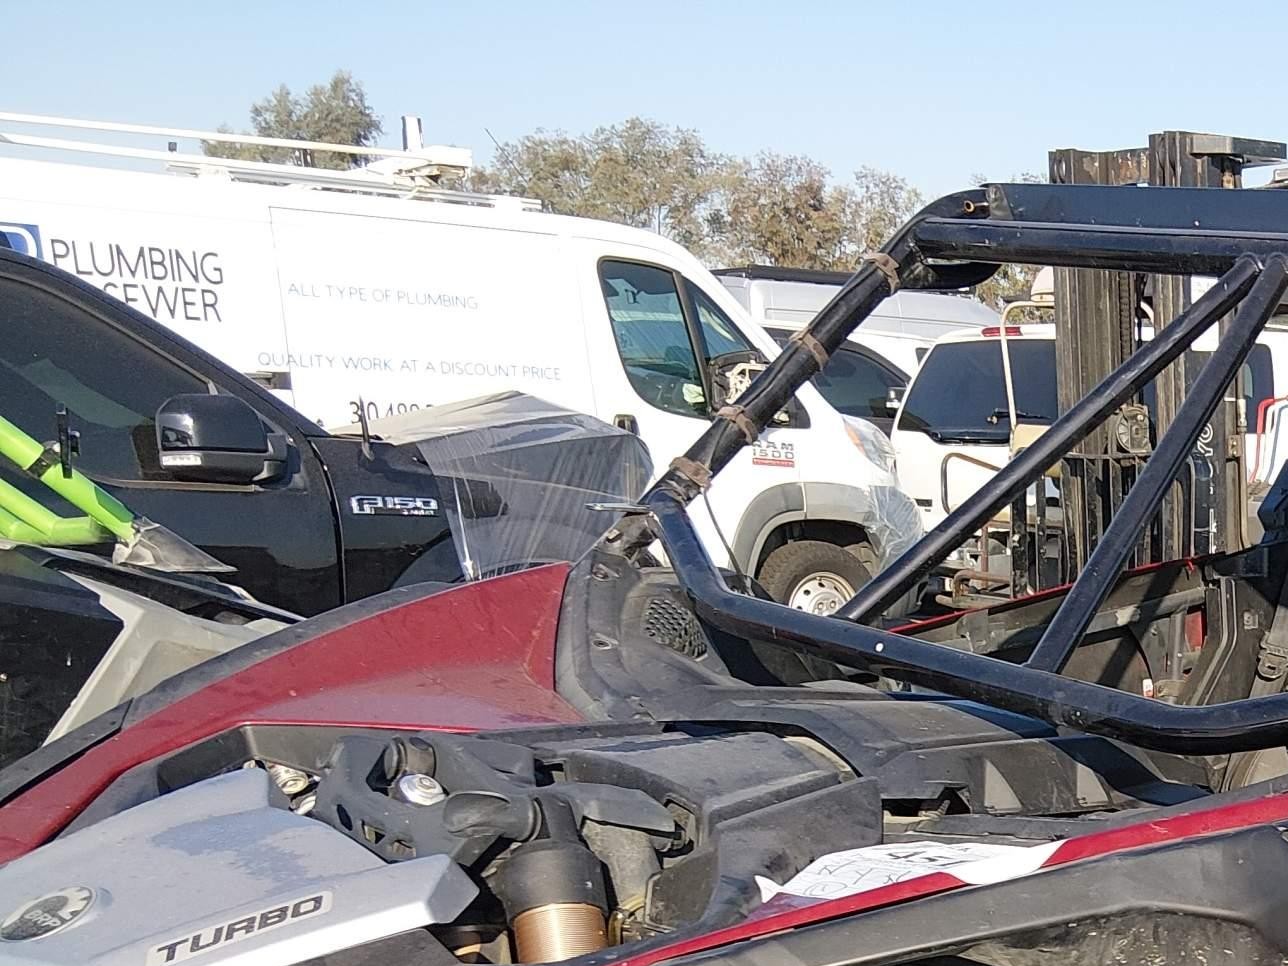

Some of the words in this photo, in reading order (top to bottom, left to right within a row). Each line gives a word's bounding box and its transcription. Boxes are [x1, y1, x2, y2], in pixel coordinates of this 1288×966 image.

[50, 238, 224, 285] PLUMBING
[288, 282, 321, 298] ALL
[325, 284, 368, 302] TYPE
[372, 288, 391, 303] OF
[397, 289, 480, 310] PLUMBING
[257, 351, 335, 369] QUALITY
[342, 356, 394, 373] WORK
[400, 358, 419, 374] AT
[425, 360, 437, 374] A
[440, 360, 518, 379] DISCOUNT
[522, 365, 562, 381] PRICE
[752, 440, 795, 451] RAM
[752, 448, 795, 460] 1500
[23, 909, 62, 927] BRP
[156, 895, 324, 963] TURBO
